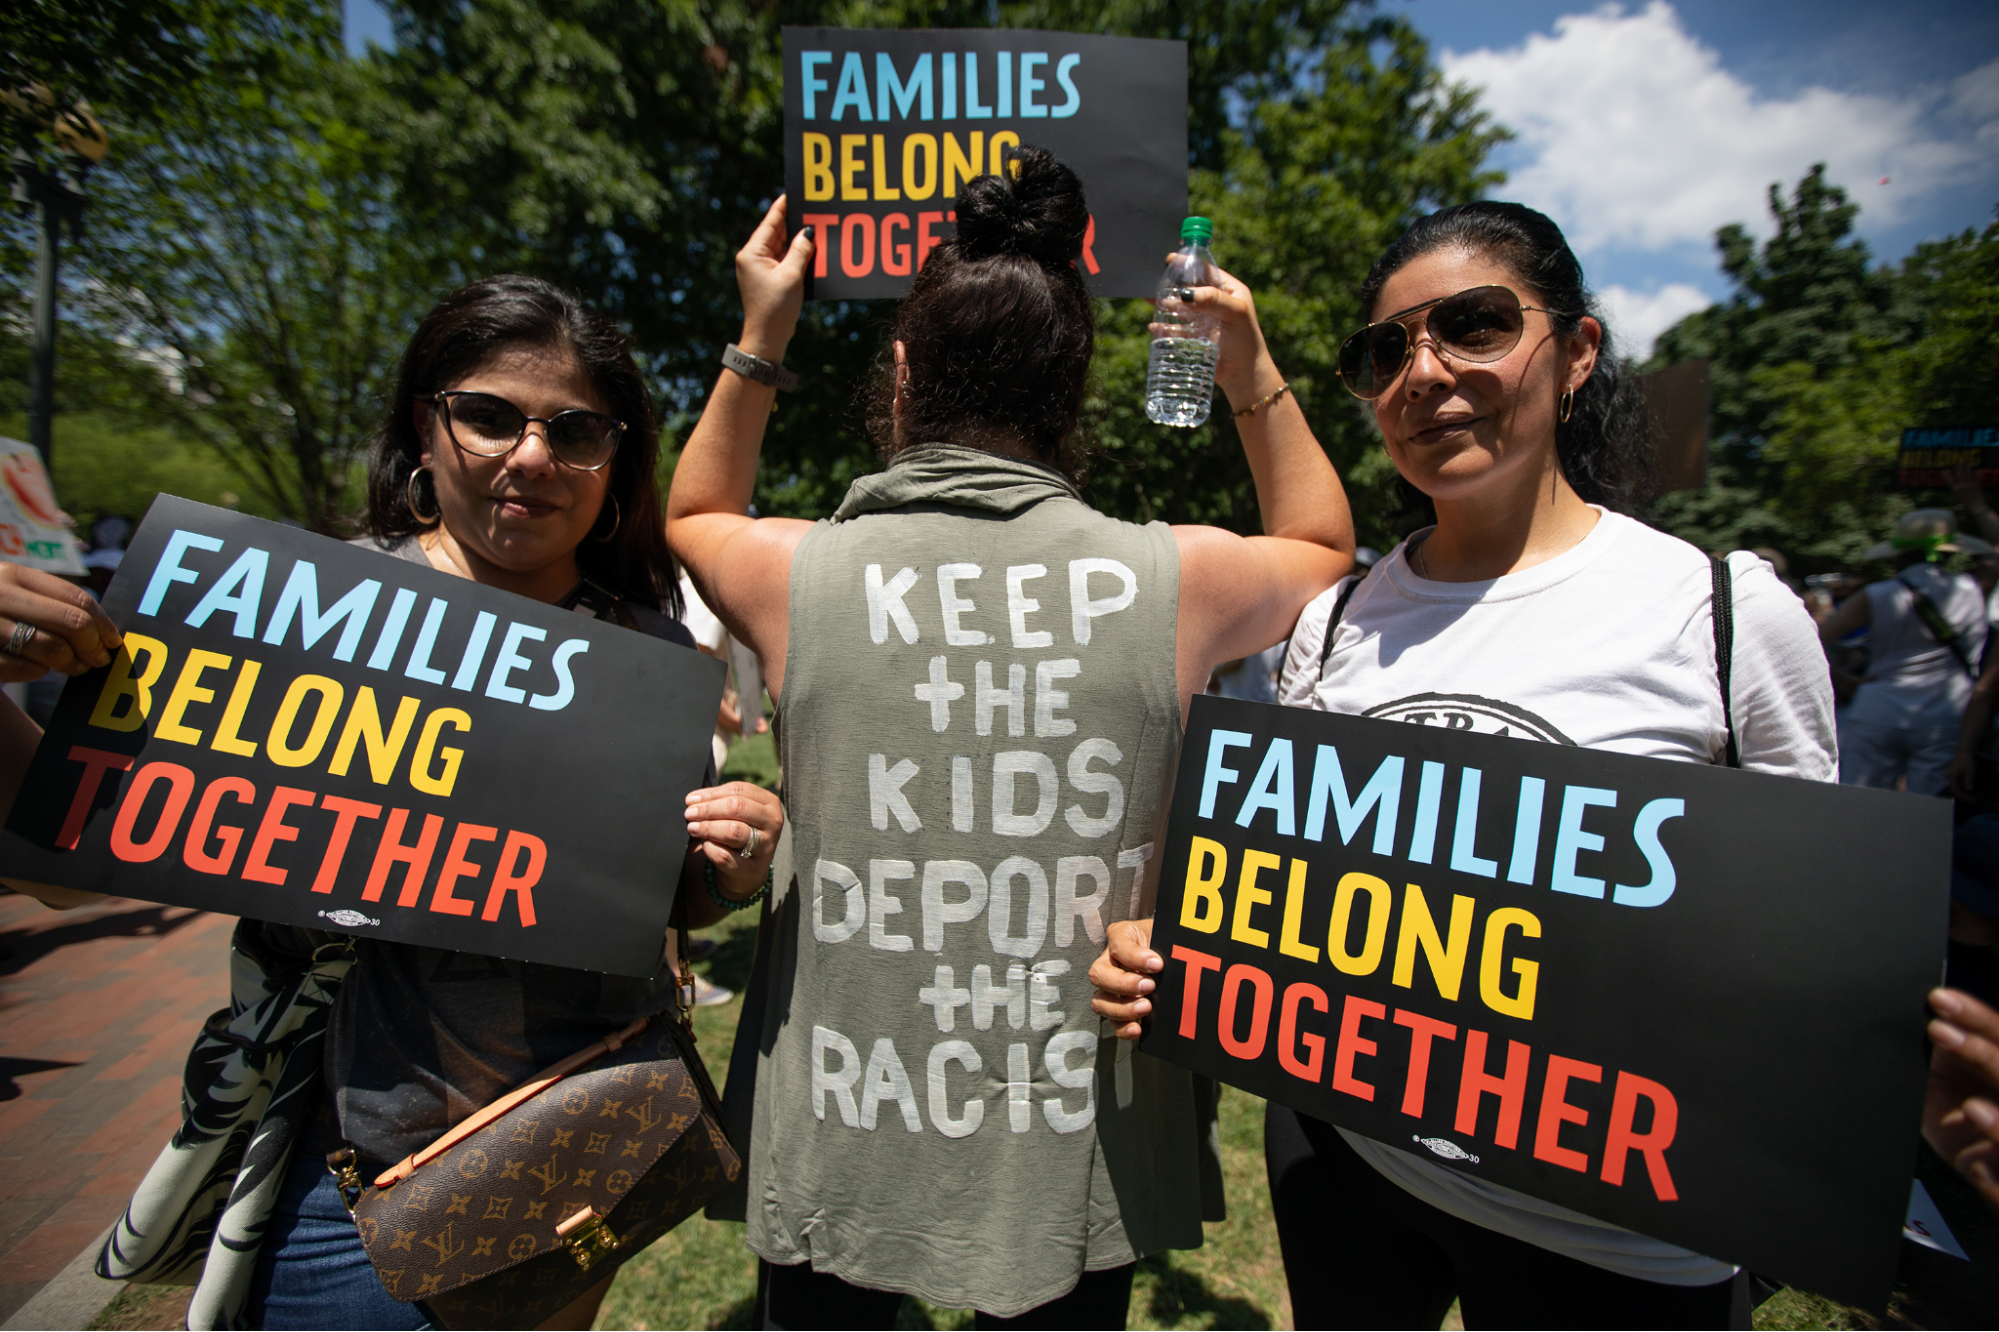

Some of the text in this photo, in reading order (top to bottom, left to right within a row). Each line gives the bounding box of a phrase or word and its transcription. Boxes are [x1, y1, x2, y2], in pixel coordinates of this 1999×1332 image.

[801, 51, 1081, 122] FAMILIES
[802, 131, 1022, 202] BELONG
[137, 529, 590, 712] FAMILIES
[864, 557, 1139, 649] KEEP
[88, 631, 472, 798] BELONG
[868, 737, 1125, 838] KIDS
[54, 745, 548, 929] TOGETHER
[812, 841, 1155, 959] DEPORT
[1197, 728, 1686, 908] FAMILIES
[1178, 834, 1542, 1021] BELONG
[1170, 943, 1680, 1202] TOGETHER
